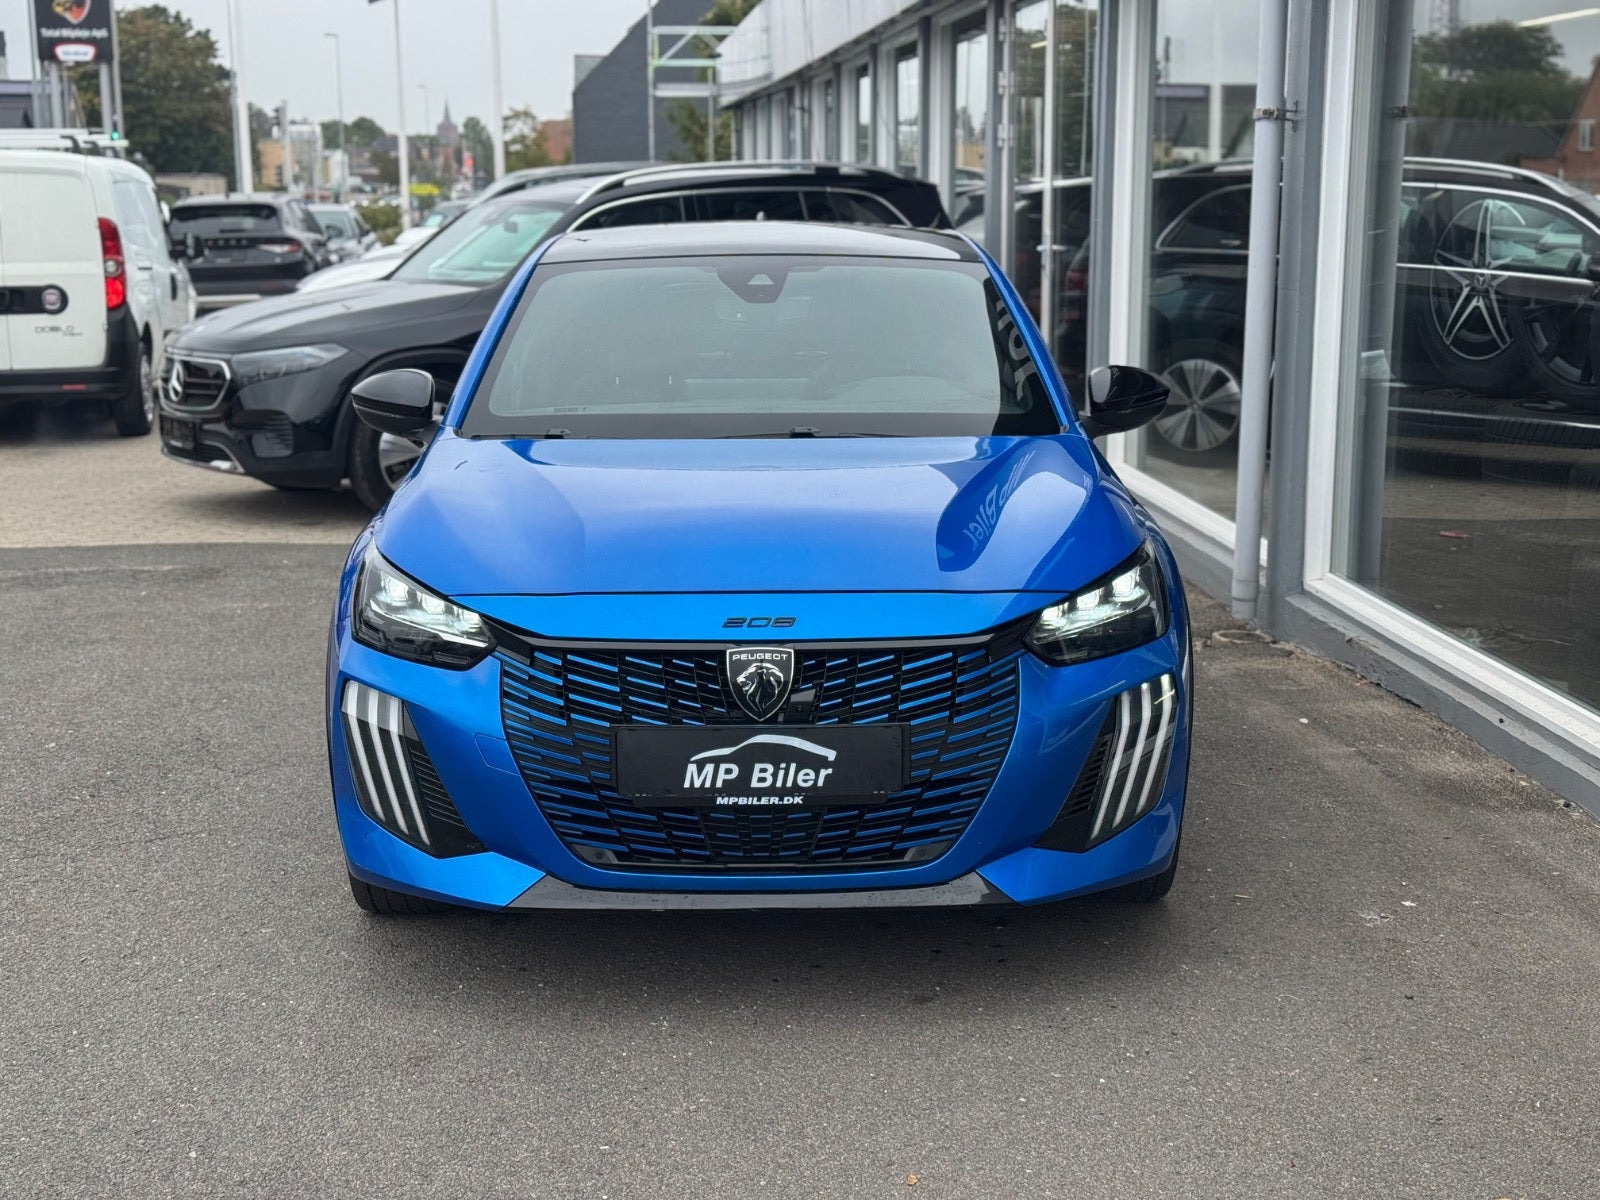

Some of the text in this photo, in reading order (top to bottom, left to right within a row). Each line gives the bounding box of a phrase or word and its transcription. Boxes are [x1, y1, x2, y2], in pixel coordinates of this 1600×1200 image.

[40, 27, 60, 38] Total
[722, 616, 796, 628] 208
[732, 653, 788, 661] PEUGEOT
[683, 763, 833, 788] MP Biler
[716, 795, 804, 805] MPBILER.DK
